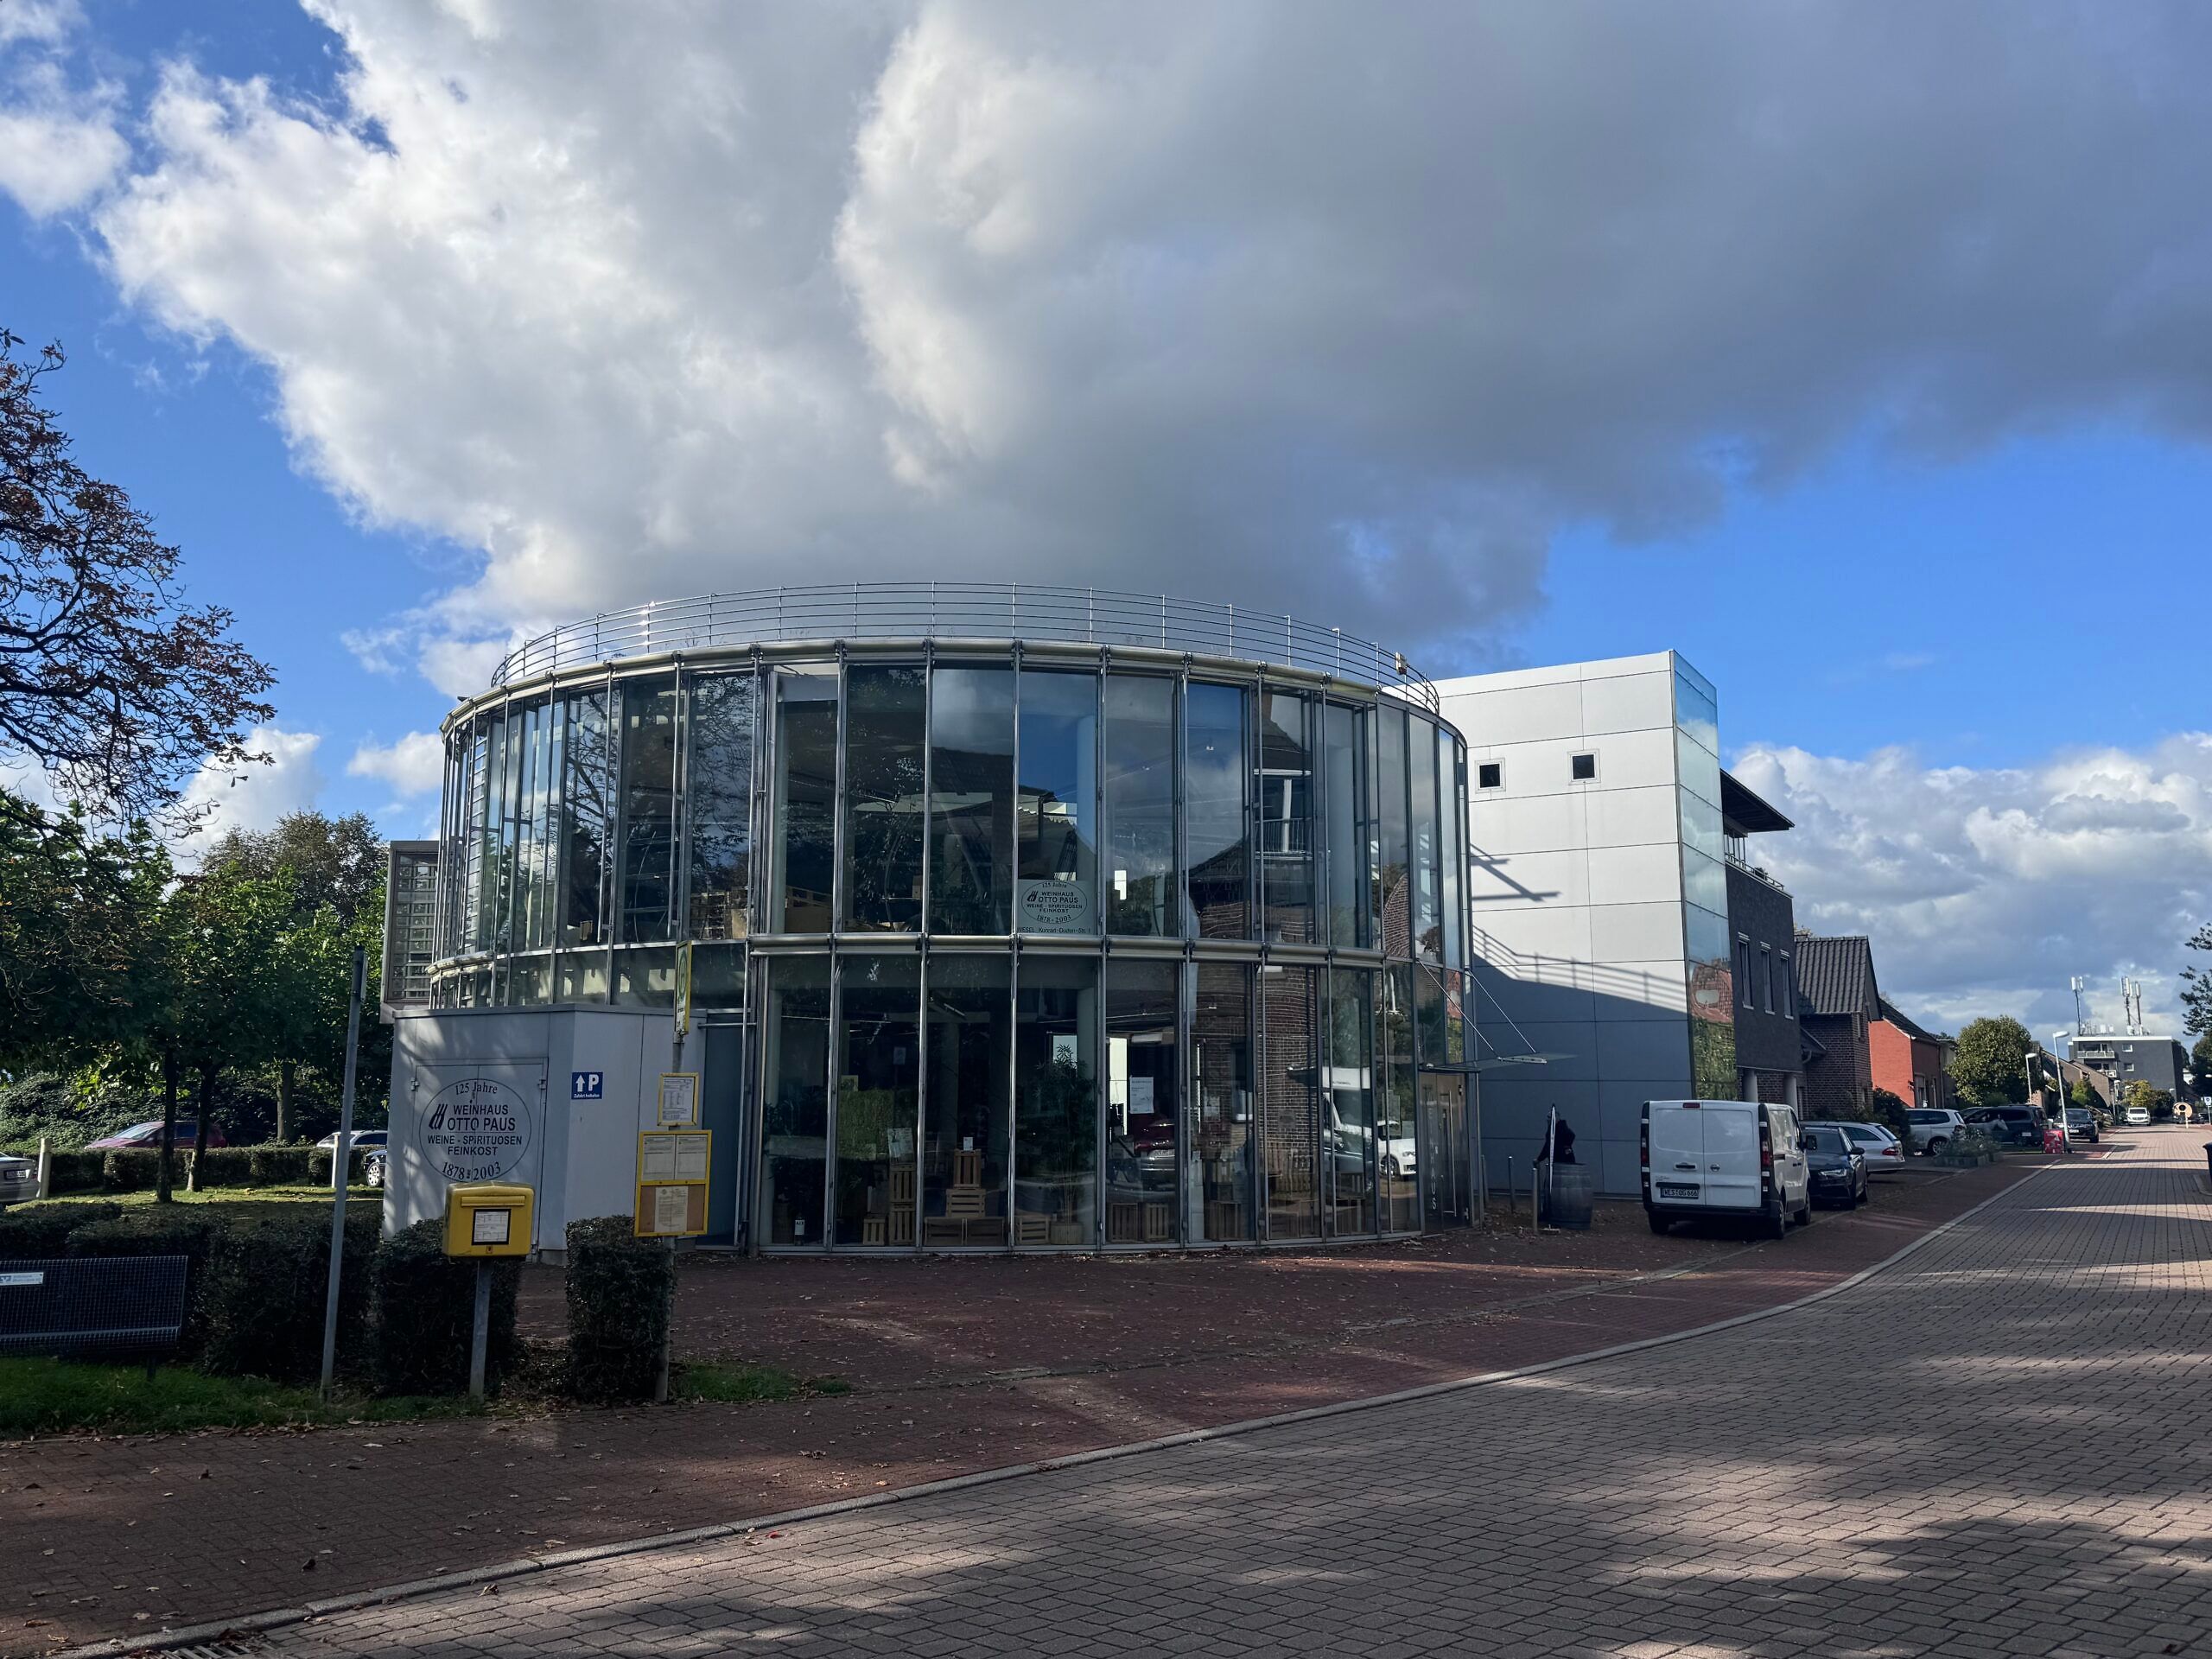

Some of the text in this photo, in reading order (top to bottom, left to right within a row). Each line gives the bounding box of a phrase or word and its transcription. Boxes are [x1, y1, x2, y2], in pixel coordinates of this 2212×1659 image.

[455, 1082, 498, 1096] 125 Jahre
[588, 1074, 599, 1091] P
[453, 1104, 508, 1116] WEINHAUS
[447, 1117, 516, 1131] OTTO PAUS
[428, 1135, 454, 1144] WEINE
[462, 1135, 522, 1145] SPIRITUOSEN
[448, 1146, 499, 1156] FEINKOST
[442, 1161, 501, 1181] 1878 2003
